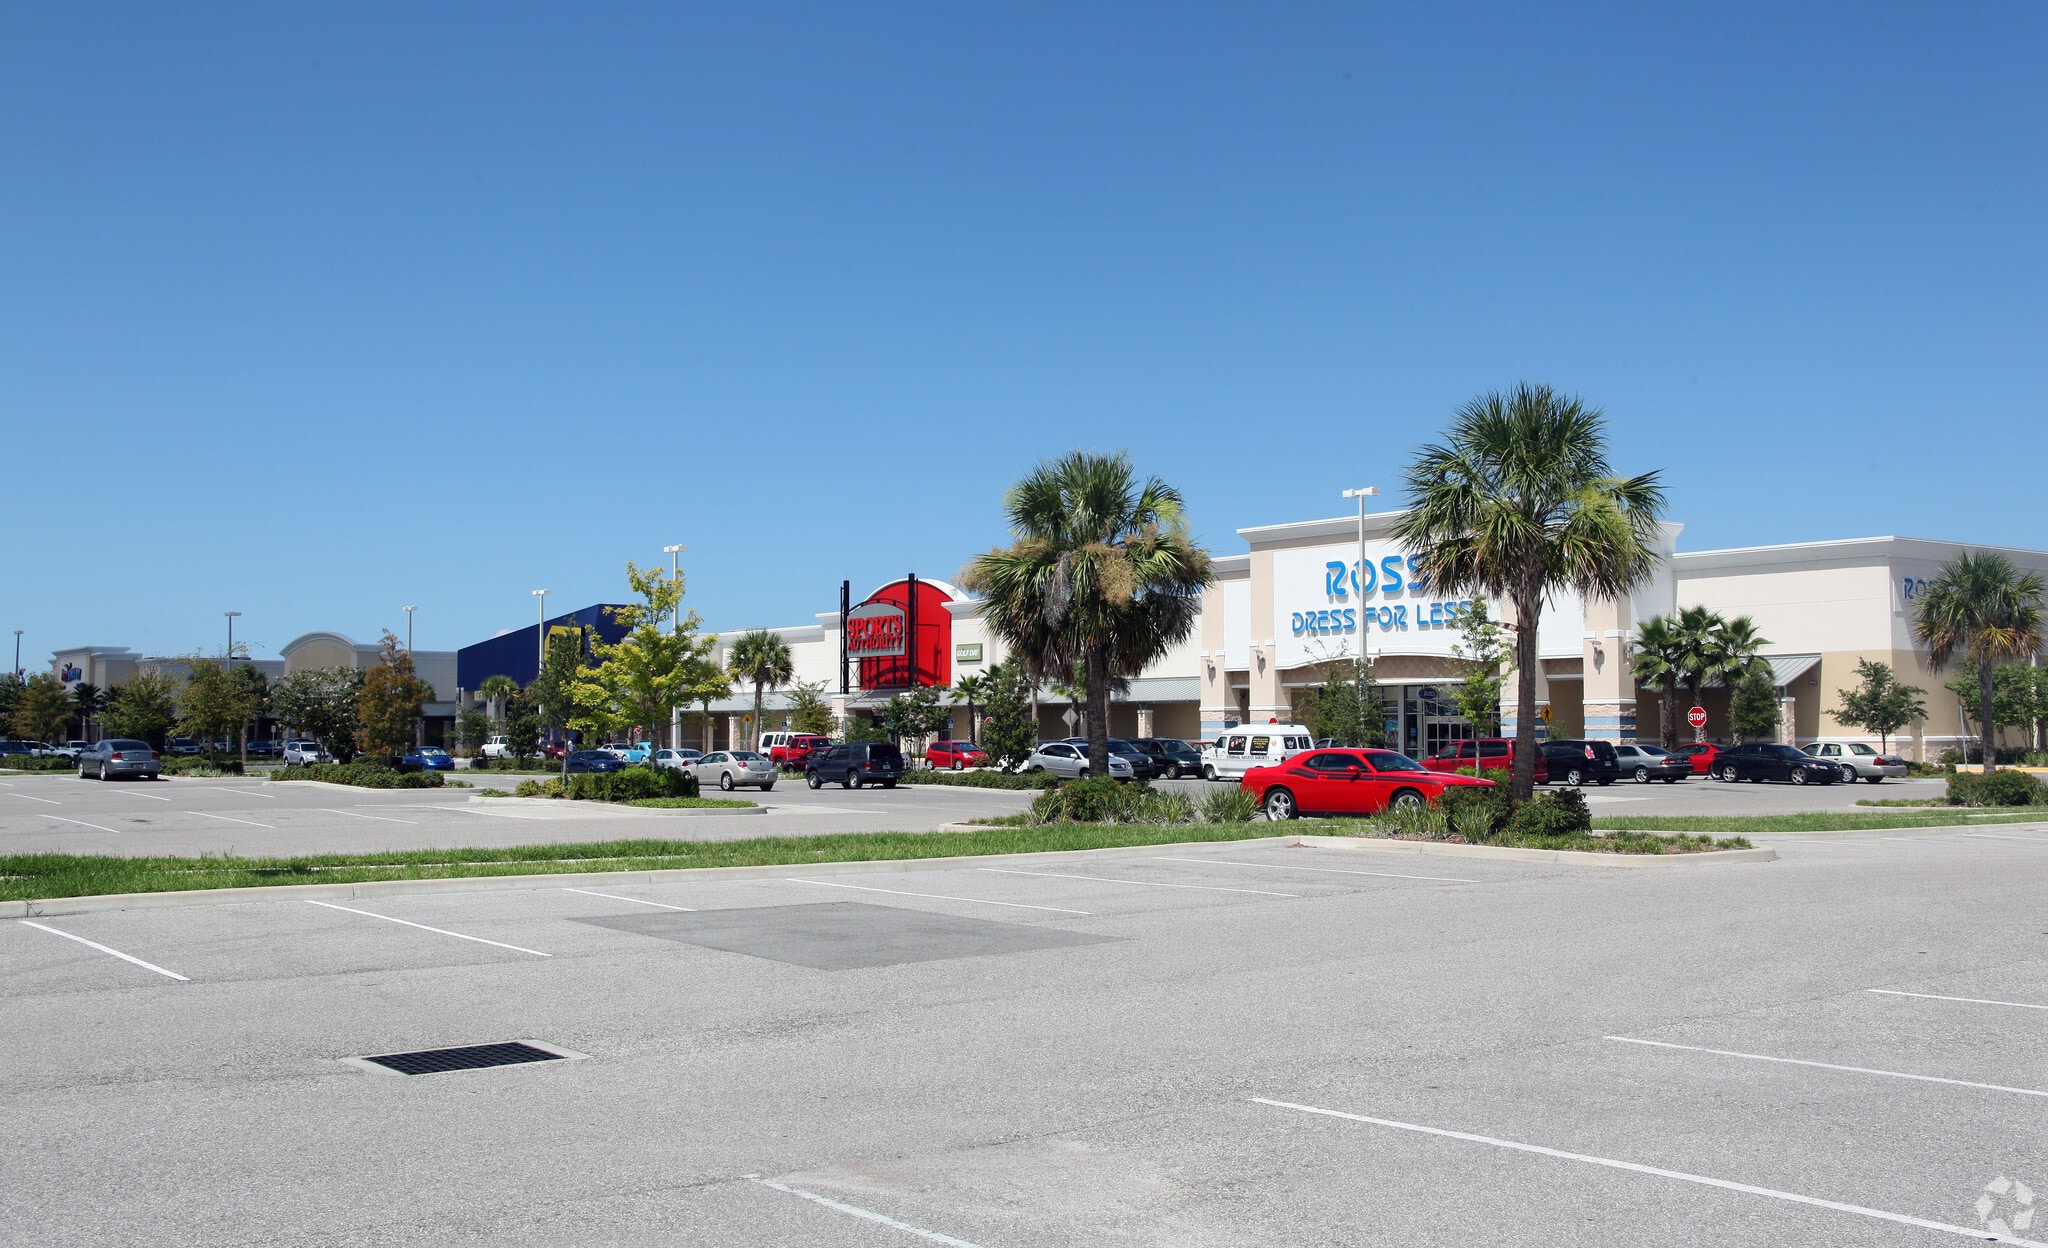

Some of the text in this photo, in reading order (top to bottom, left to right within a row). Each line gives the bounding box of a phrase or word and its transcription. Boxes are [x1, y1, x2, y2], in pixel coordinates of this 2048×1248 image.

[1326, 553, 1429, 596] ROSS
[847, 614, 903, 638] SPORTS
[1292, 600, 1472, 633] DRESS FOR LESS
[848, 636, 903, 651] AUTHORITY
[1689, 712, 1705, 721] STOP
